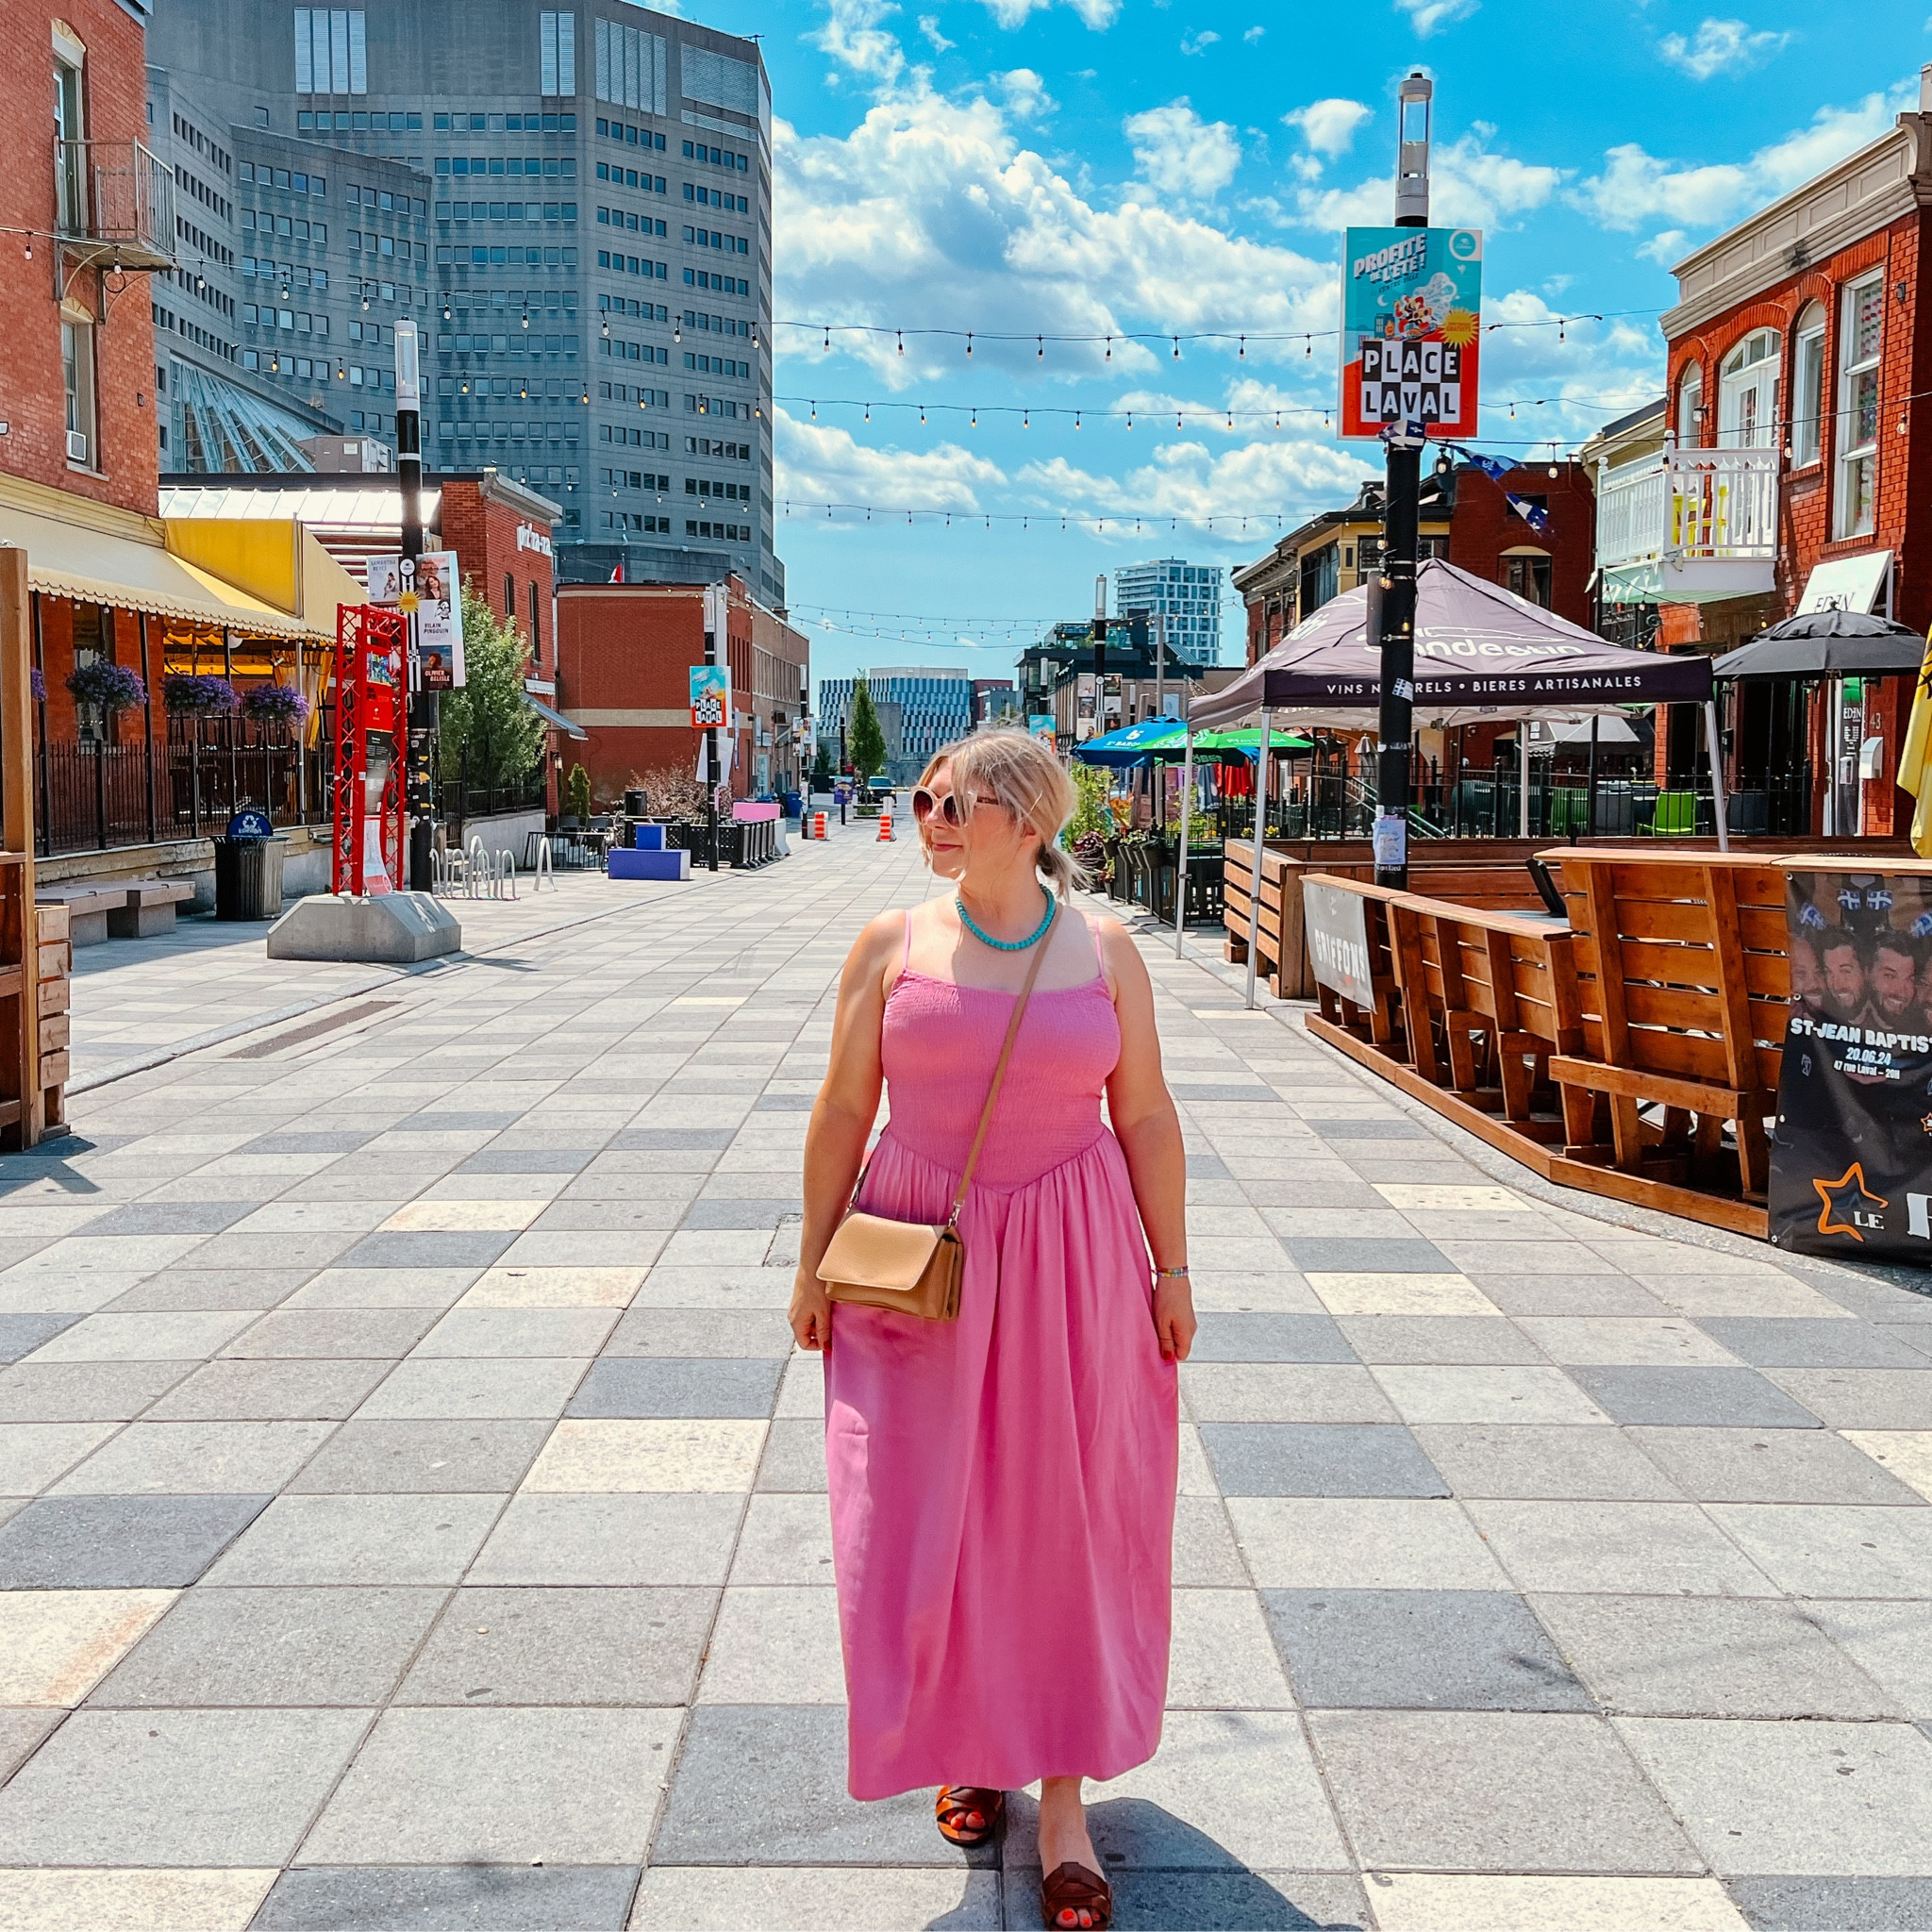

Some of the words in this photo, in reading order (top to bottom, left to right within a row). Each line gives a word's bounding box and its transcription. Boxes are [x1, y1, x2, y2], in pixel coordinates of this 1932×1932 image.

[1354, 233, 1427, 280] PROFITE
[1364, 349, 1457, 375] PLACE
[1365, 391, 1457, 414] LAVAL
[1326, 684, 1363, 695] VINS
[1371, 682, 1452, 693] NRELS
[1473, 680, 1526, 691] BIERES
[1534, 675, 1642, 691] ARTISANALES
[695, 701, 722, 709] PLACE
[696, 713, 722, 722] LAVAL
[1869, 712, 1881, 729] 43
[1314, 928, 1366, 983] GRIFFONS
[1790, 1018, 1861, 1044] ST-JEAN
[1845, 1047, 1892, 1066] 20.06.24
[1833, 1060, 1842, 1072] 47
[1843, 1062, 1857, 1074] rue
[1857, 1063, 1877, 1076] Laval
[1853, 1210, 1885, 1230] LE
